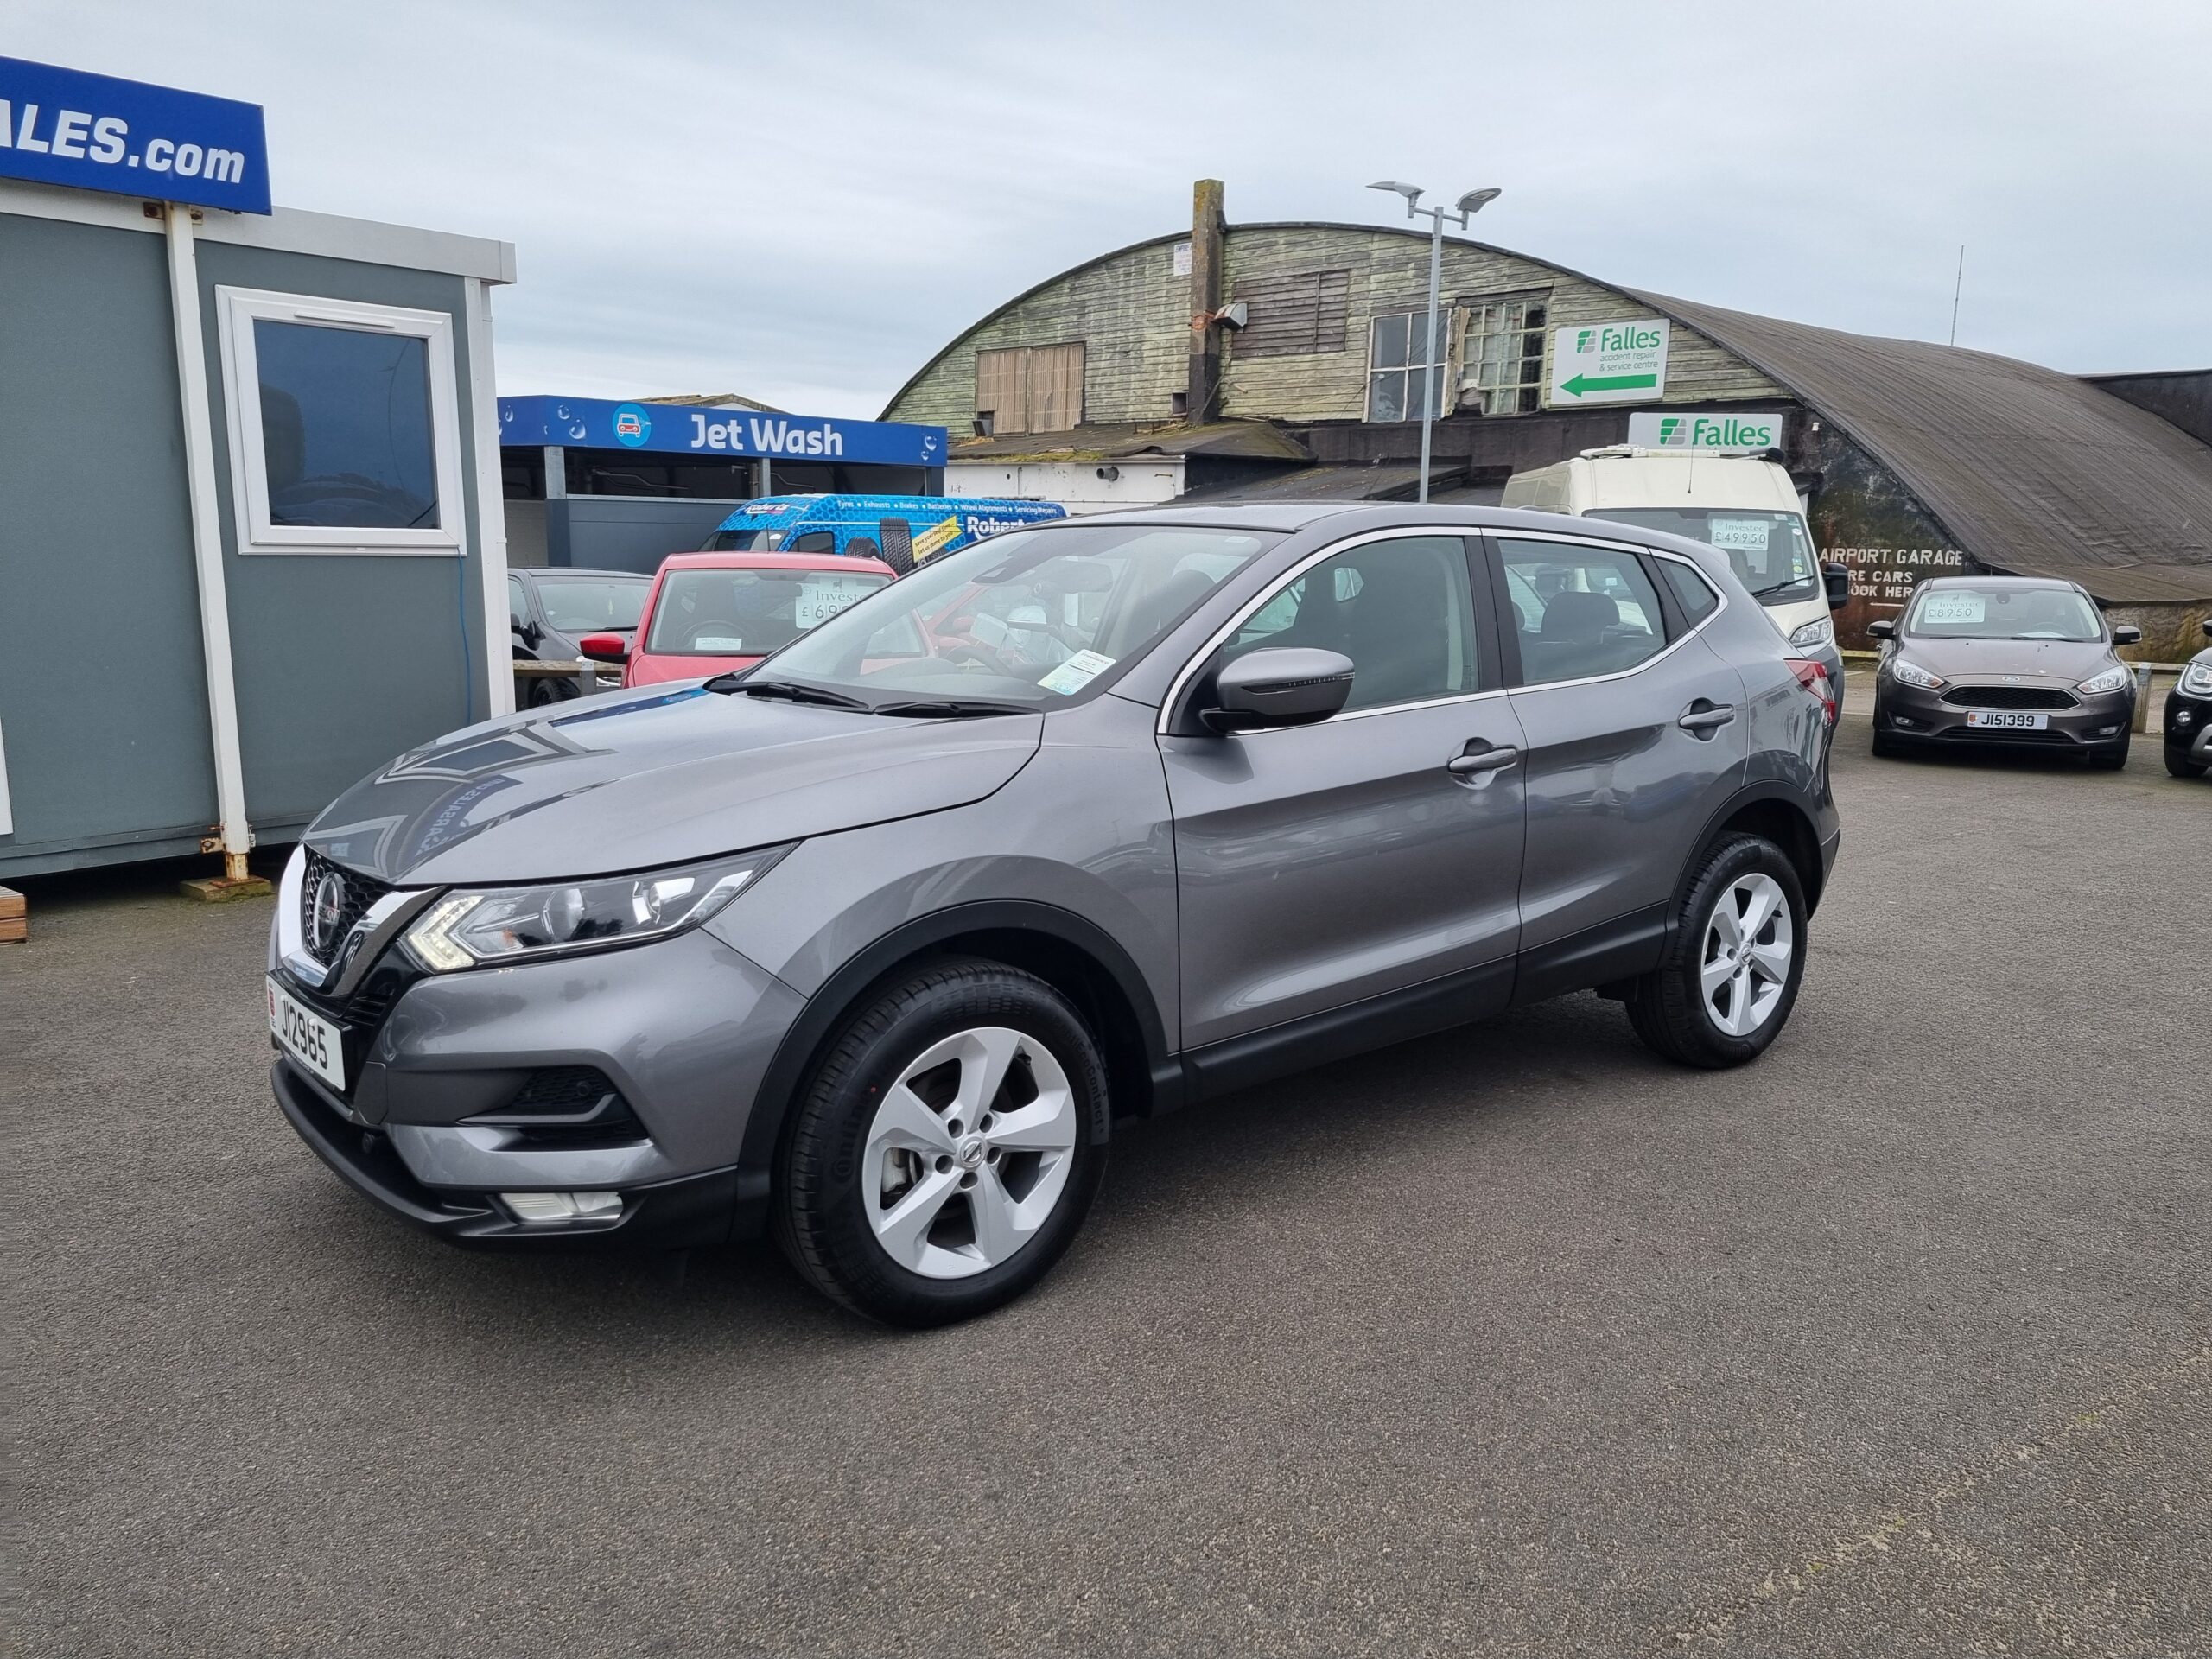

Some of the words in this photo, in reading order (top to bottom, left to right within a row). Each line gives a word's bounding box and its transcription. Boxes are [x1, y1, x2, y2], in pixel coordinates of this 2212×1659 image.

[1601, 326, 1661, 352] Falles
[1600, 353, 1631, 362] accident
[1633, 351, 1656, 360] repair
[1599, 363, 1605, 372] &
[1606, 362, 1632, 372] service
[1633, 361, 1659, 370] centre
[691, 414, 744, 451] Jet
[749, 418, 843, 456] Wash
[1692, 418, 1771, 447] Falles
[864, 500, 891, 509] Exhausts
[967, 516, 1033, 538] Robert
[1819, 548, 1891, 563] AIRPORT
[1897, 550, 1964, 566] GARAGE
[1872, 570, 1913, 583] CARS
[1847, 584, 1878, 597] OOK
[802, 604, 849, 619] £69
[1929, 608, 1973, 618] £8950
